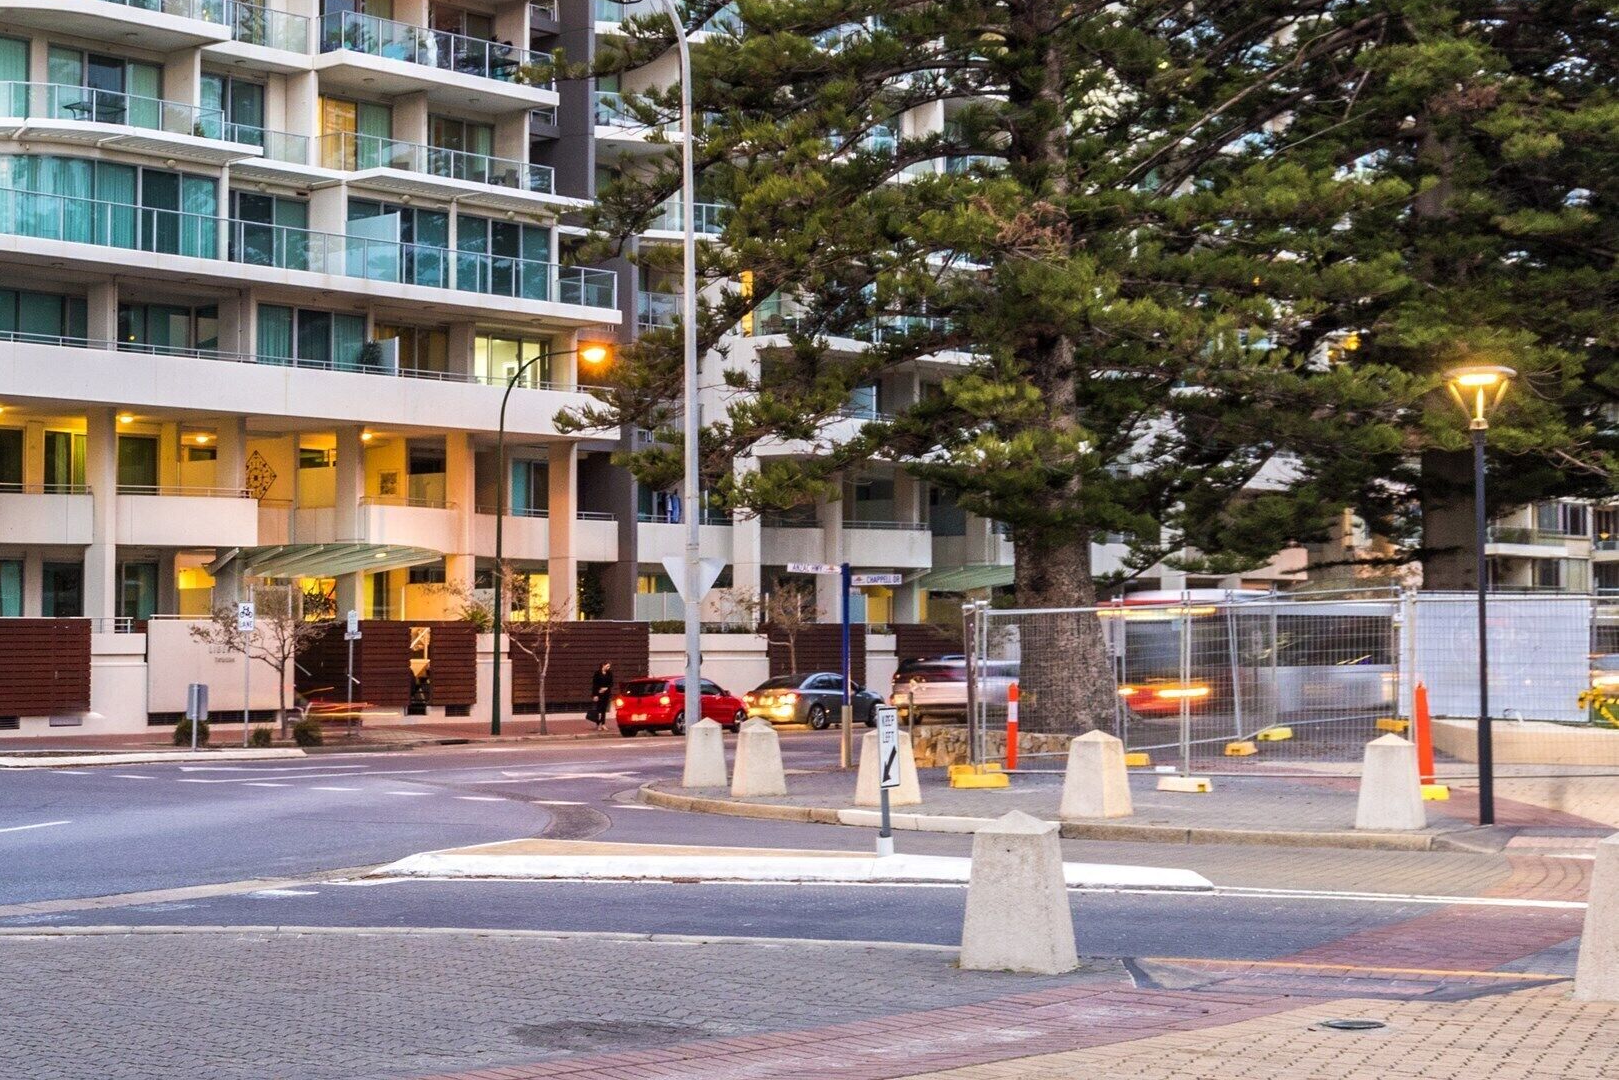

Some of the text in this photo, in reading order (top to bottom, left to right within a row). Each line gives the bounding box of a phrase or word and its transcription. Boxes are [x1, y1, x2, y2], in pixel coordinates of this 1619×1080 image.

[811, 564, 823, 572] HWY
[866, 575, 900, 584] CHAPPELL DR
[882, 715, 894, 727] KEEP
[883, 731, 894, 743] LEFT
